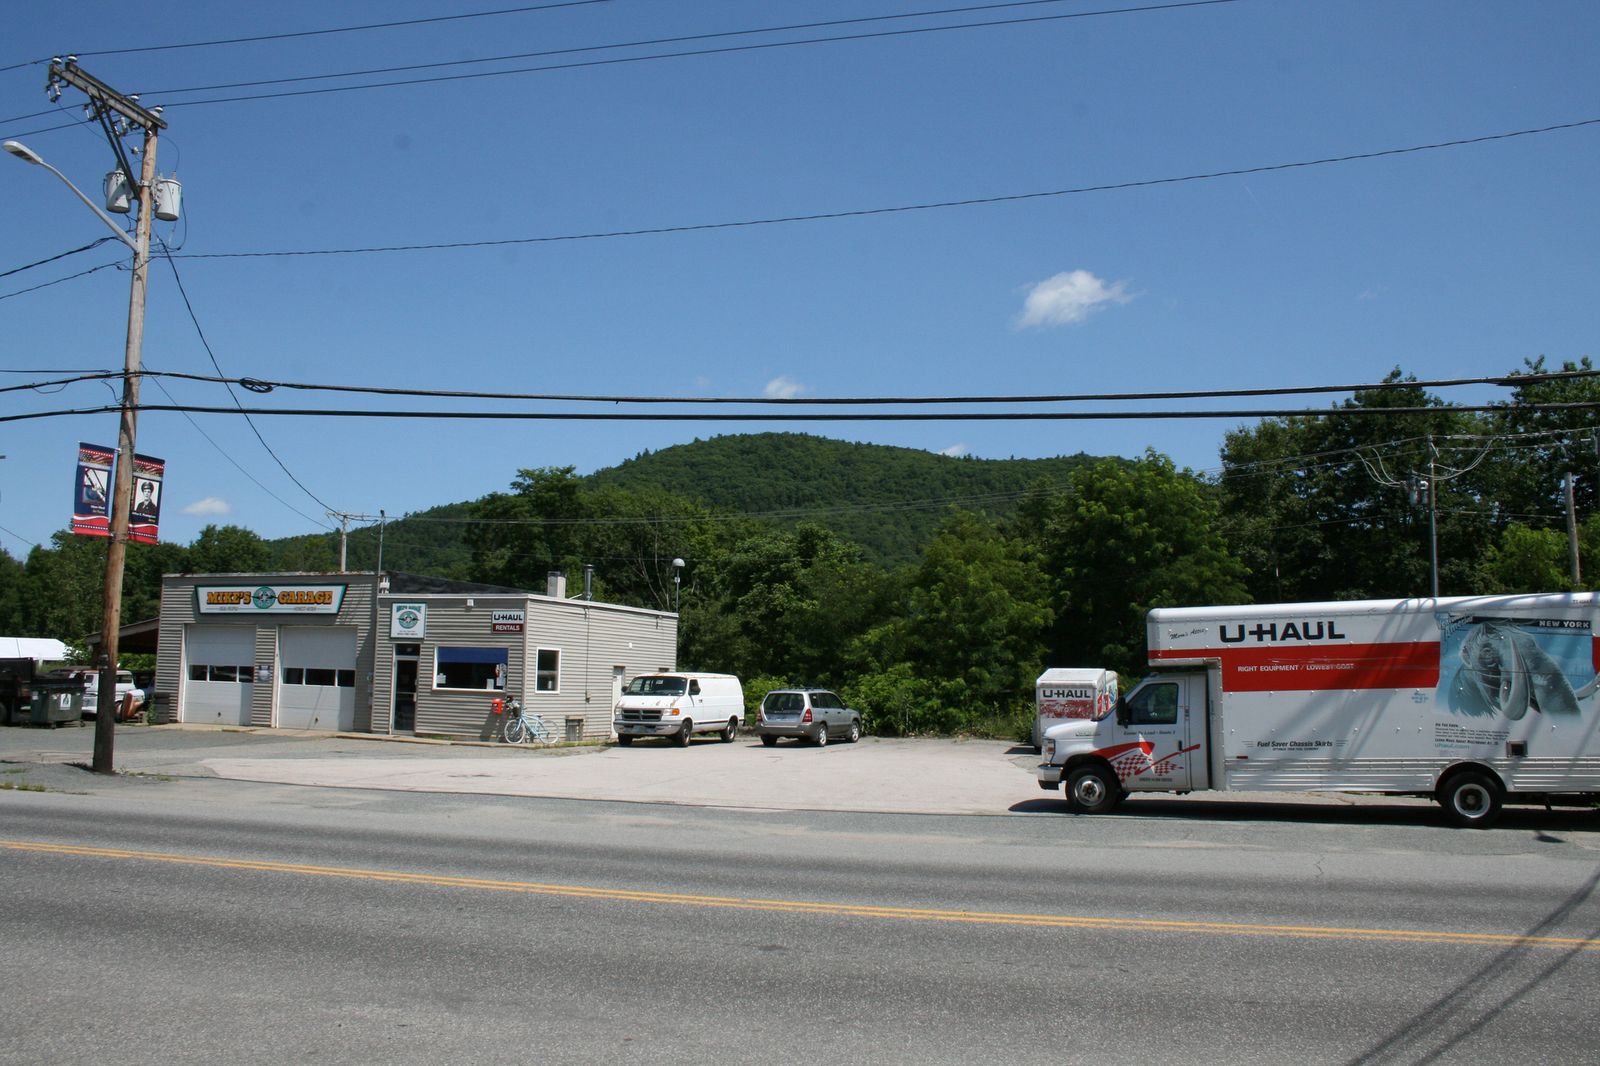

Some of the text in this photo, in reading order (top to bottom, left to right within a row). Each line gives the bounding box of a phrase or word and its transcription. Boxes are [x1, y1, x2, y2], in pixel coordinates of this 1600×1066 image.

[207, 591, 333, 604] MIKE'S GARAGE
[1539, 620, 1590, 628] NEW YORK
[1219, 621, 1346, 643] U-HAUL
[1042, 689, 1091, 698] U-HAUL
